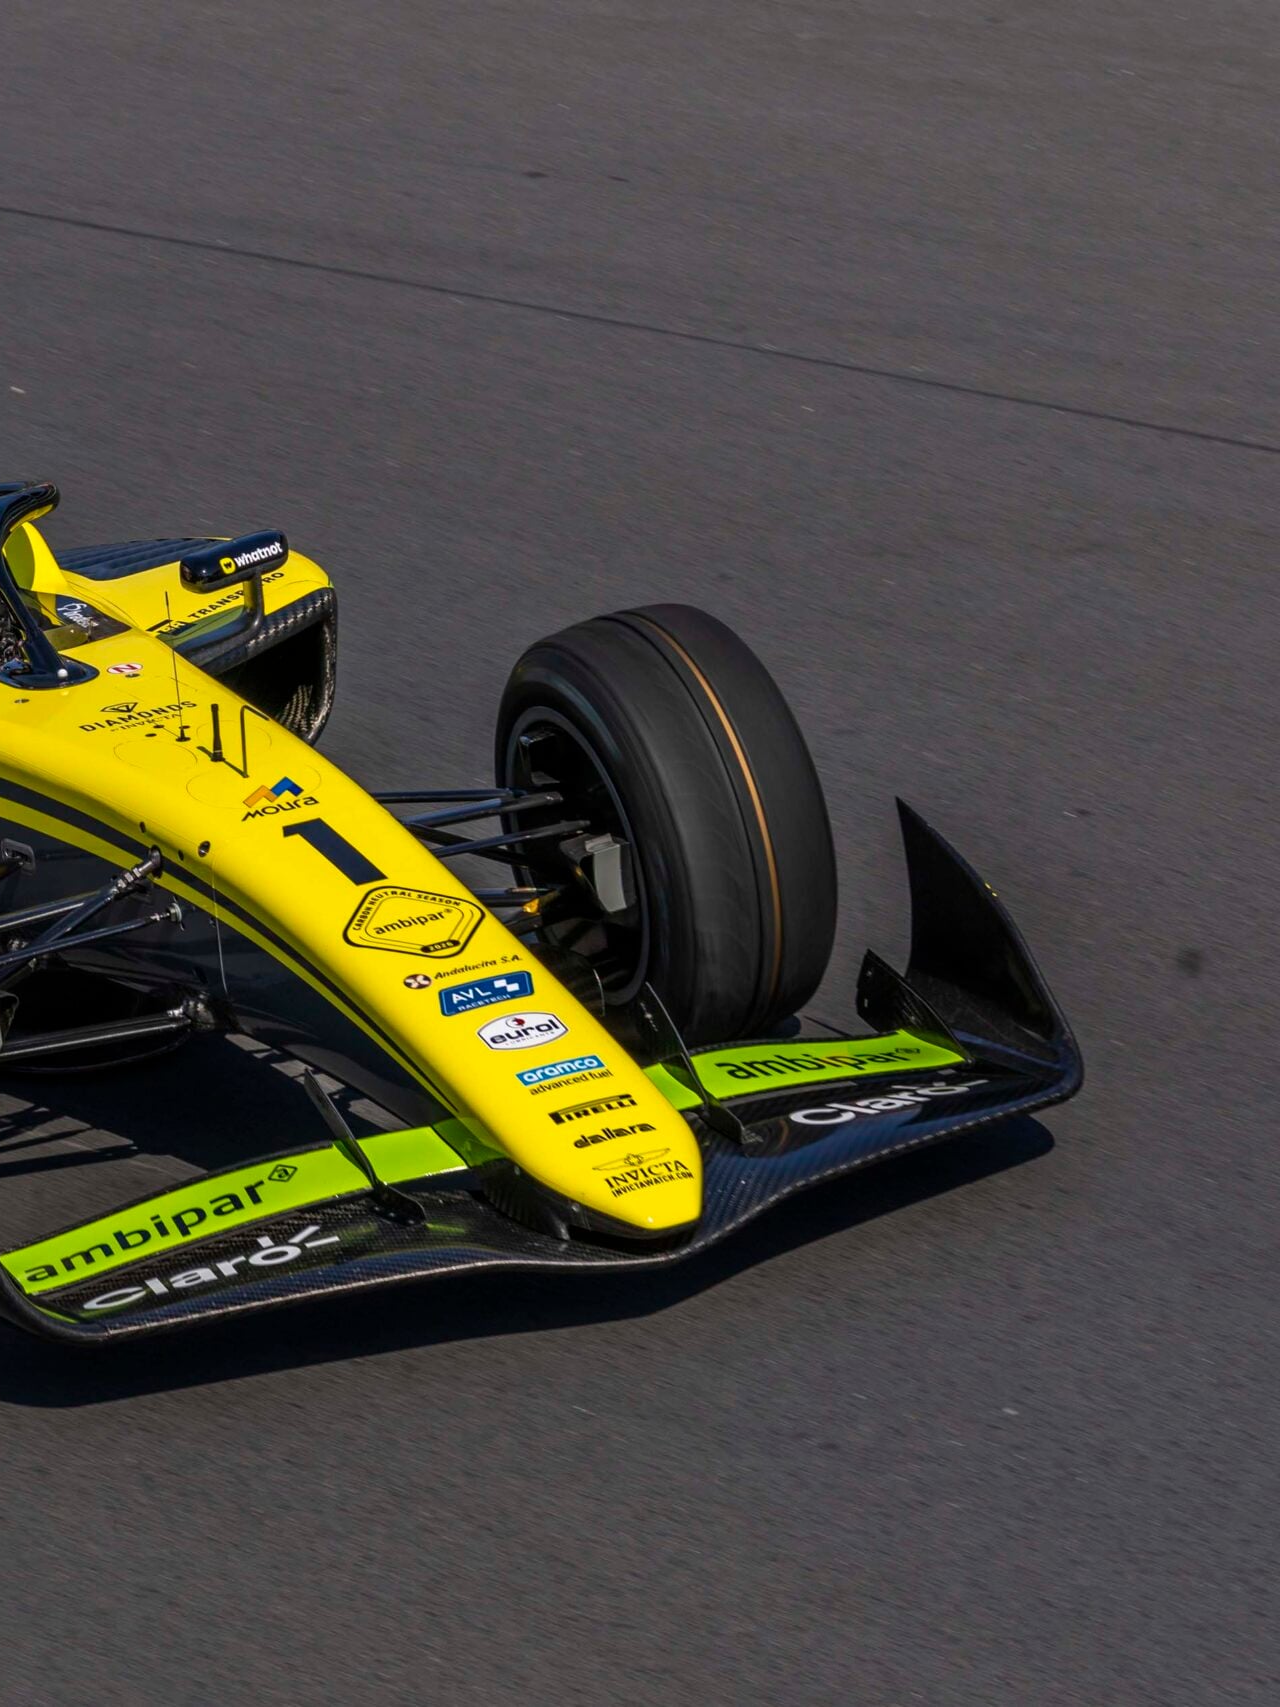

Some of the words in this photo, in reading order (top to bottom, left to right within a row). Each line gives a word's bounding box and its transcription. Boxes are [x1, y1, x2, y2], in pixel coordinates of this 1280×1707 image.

[234, 541, 283, 568] whatnot
[79, 700, 197, 732] DIAMONDS
[282, 817, 389, 886] 1
[352, 905, 373, 931] CARBON
[371, 890, 413, 907] NEUTRAL
[416, 894, 461, 906] SEASON
[373, 911, 445, 935] ambipar
[451, 987, 492, 1005] AVL
[457, 994, 512, 1012] RACETECH
[489, 1019, 560, 1045] eurol
[522, 1057, 599, 1083] aramco
[715, 1049, 912, 1080] ambipar
[529, 1073, 589, 1096] advanced
[589, 1069, 614, 1081] fuel
[548, 1093, 638, 1126] PIRELLI
[573, 1123, 657, 1149] dallara
[604, 1159, 689, 1189] INVICTA
[611, 1171, 695, 1199] INVICTAWATCH.COM
[24, 1179, 266, 1283] ambipar
